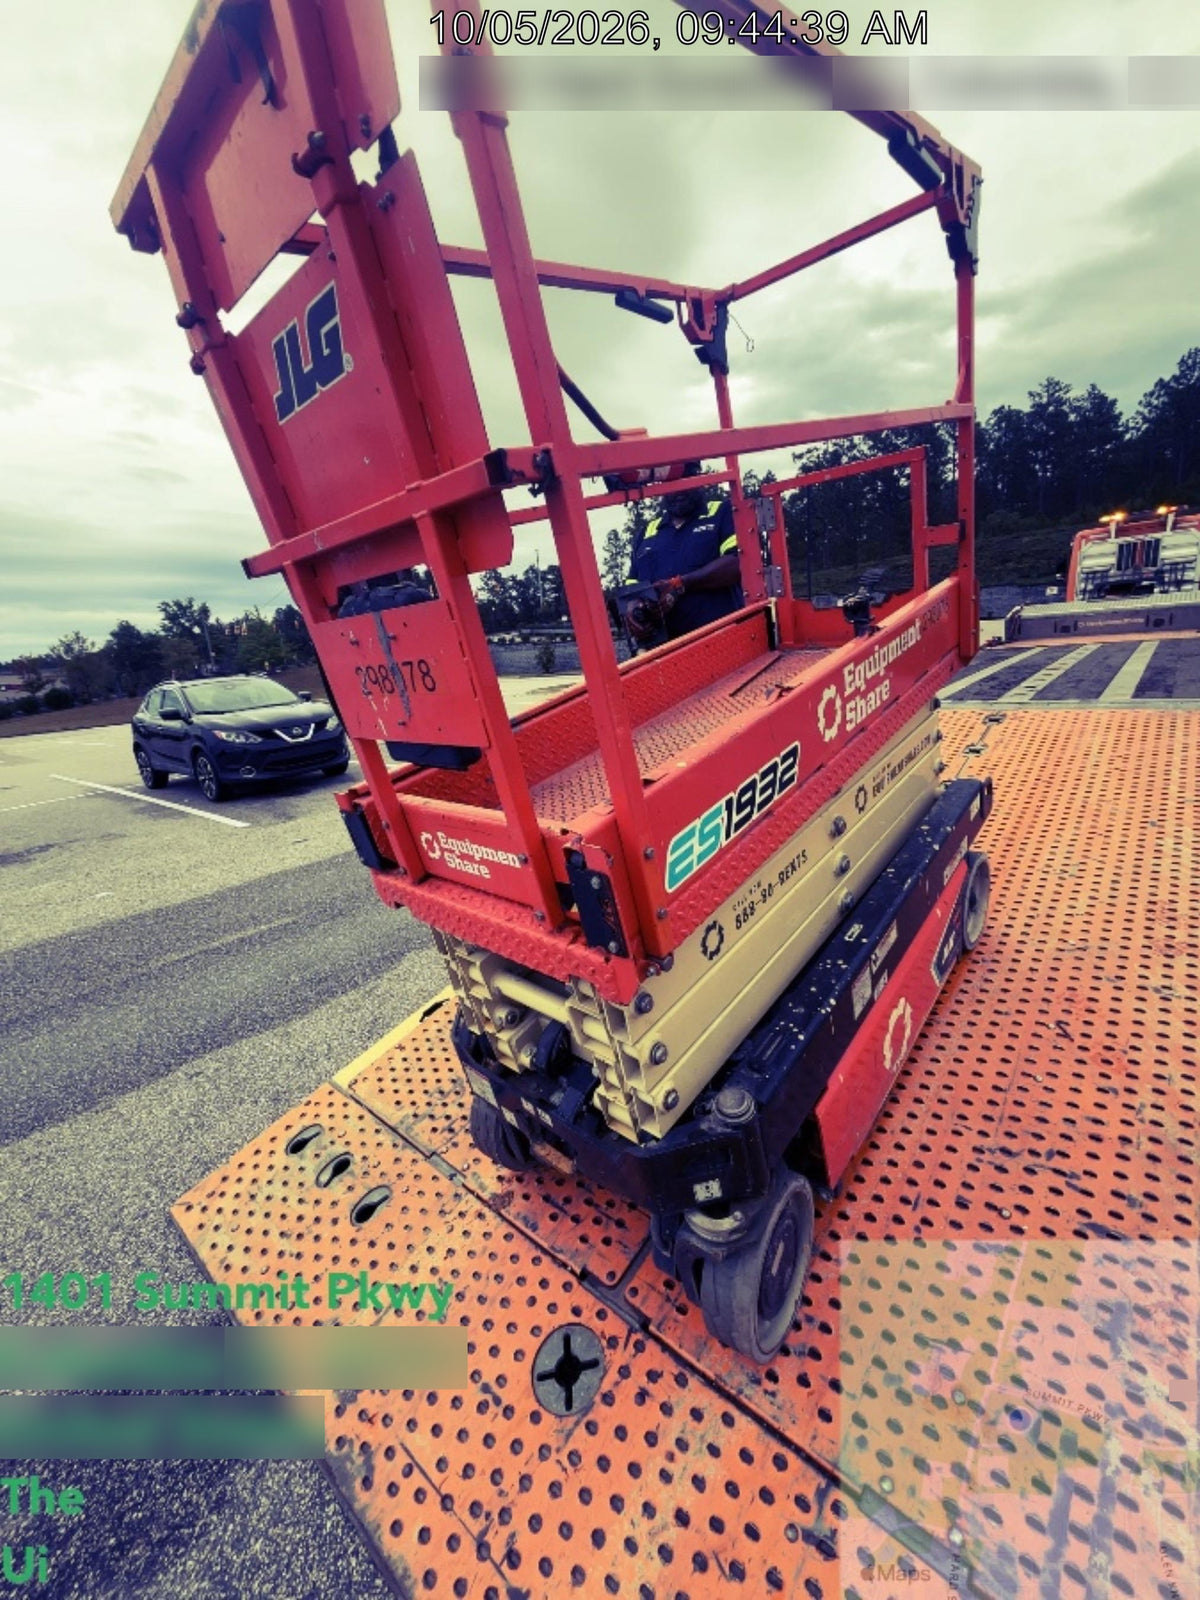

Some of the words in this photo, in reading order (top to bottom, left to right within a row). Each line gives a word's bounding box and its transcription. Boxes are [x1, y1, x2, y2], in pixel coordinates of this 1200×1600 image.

[843, 618, 922, 698] Equipment
[845, 679, 891, 732] Share
[665, 741, 800, 893] ES1932
[437, 832, 523, 869] Equipmen
[444, 852, 491, 879] Share
